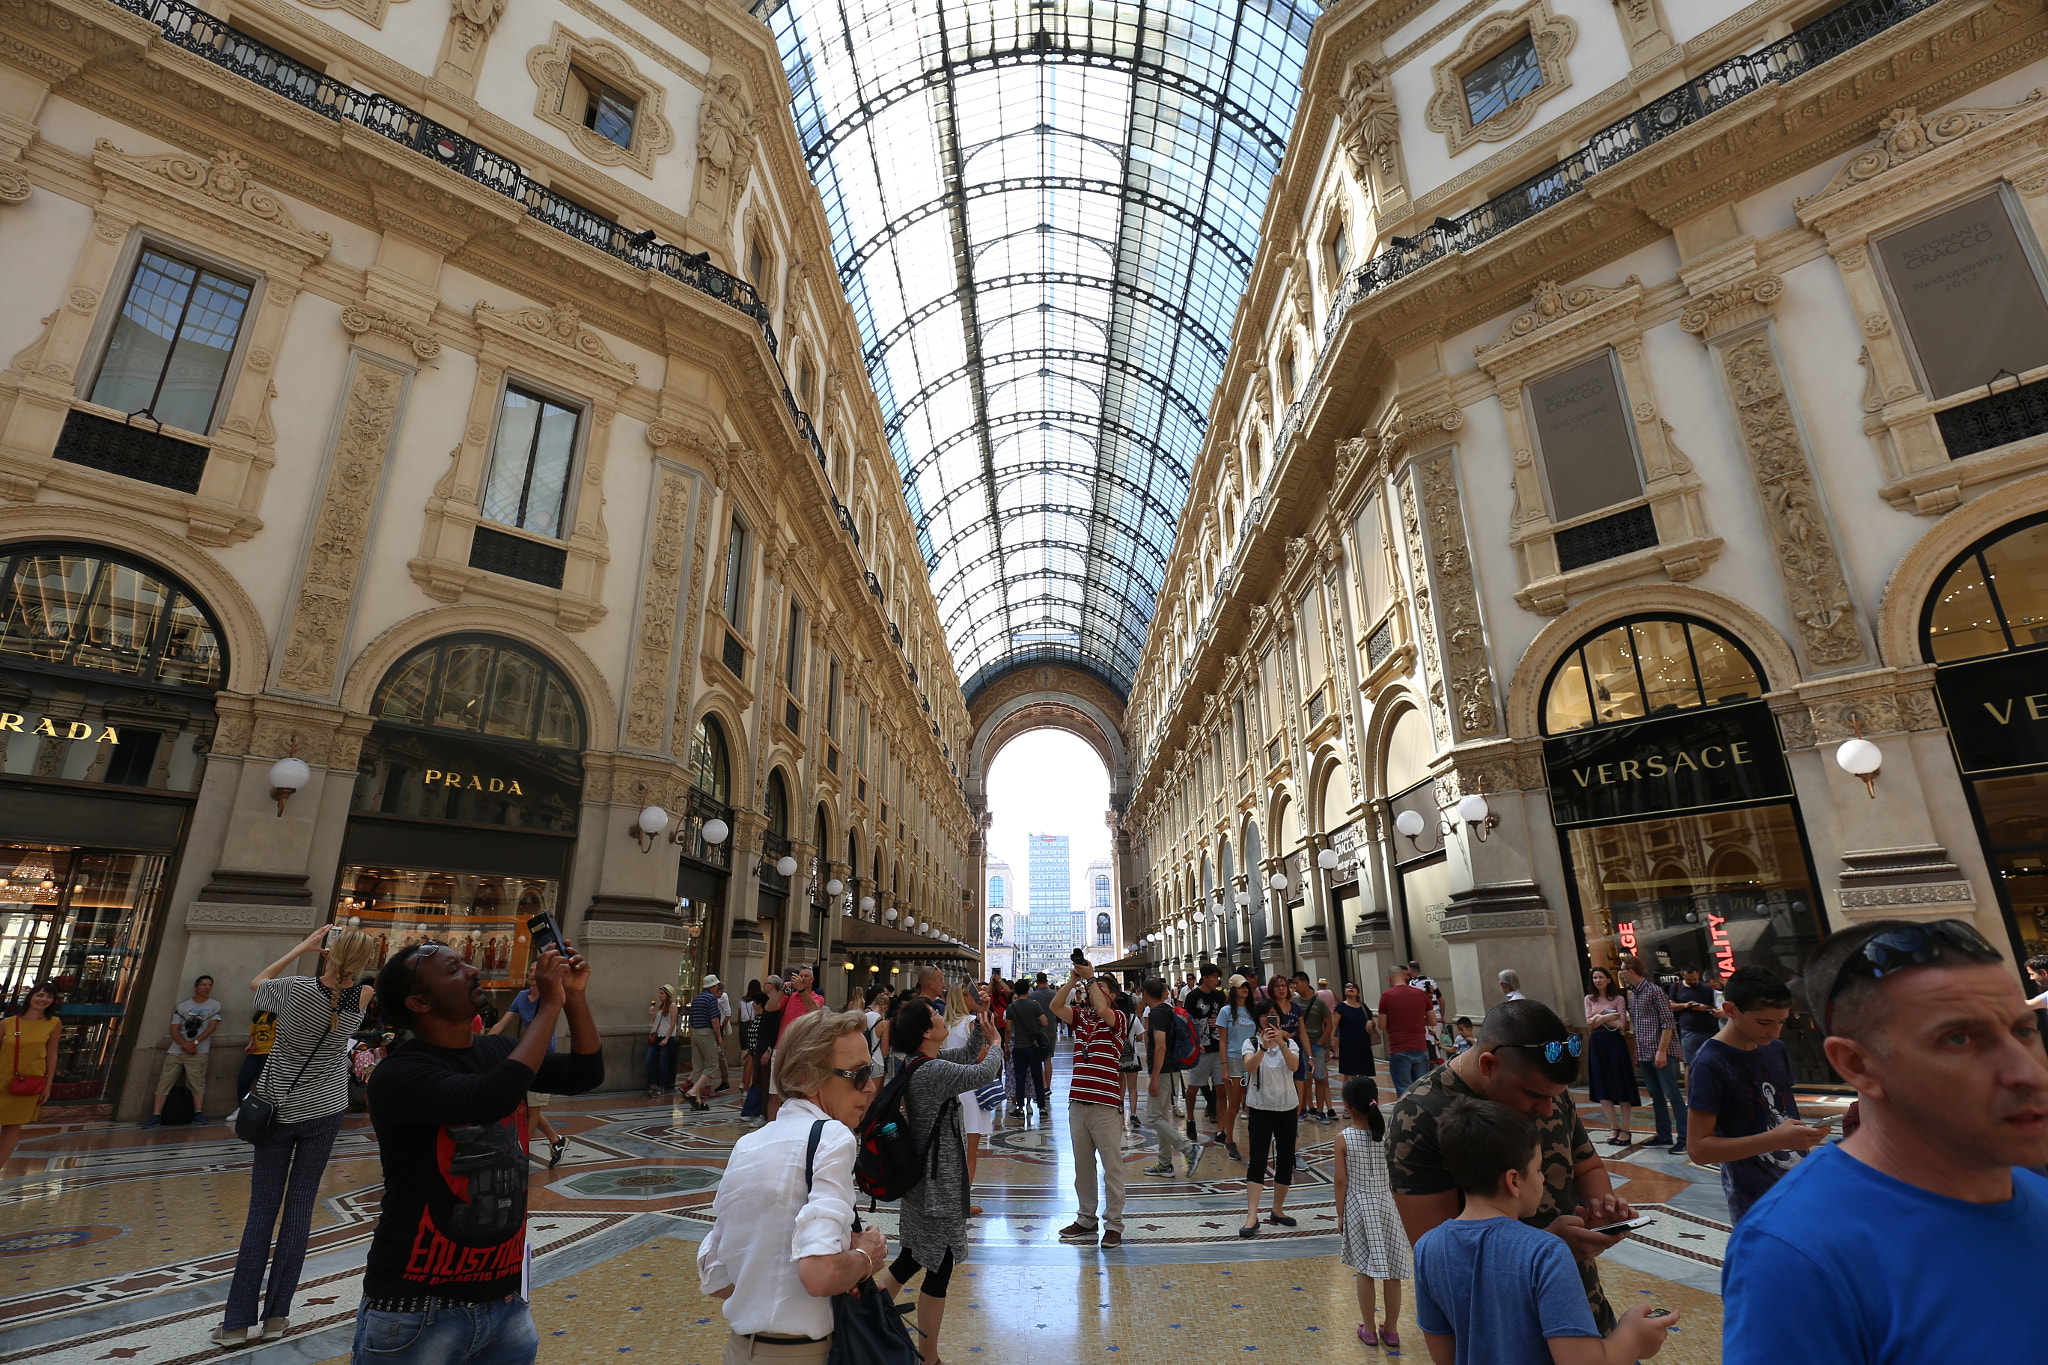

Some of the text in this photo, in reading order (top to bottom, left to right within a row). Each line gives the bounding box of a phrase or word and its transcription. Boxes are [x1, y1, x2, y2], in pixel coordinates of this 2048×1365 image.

[1902, 219, 1990, 261] RISTORANTE
[1905, 230, 1993, 271] CRACCO
[1913, 252, 2003, 292] Next opening
[1944, 273, 1978, 292] 2017
[1546, 384, 1603, 413] CRACCO
[1571, 741, 1753, 789] VERSACE
[423, 768, 524, 797] PRADA
[401, 1272, 427, 1284] THE
[428, 1271, 493, 1286] GALACTIC
